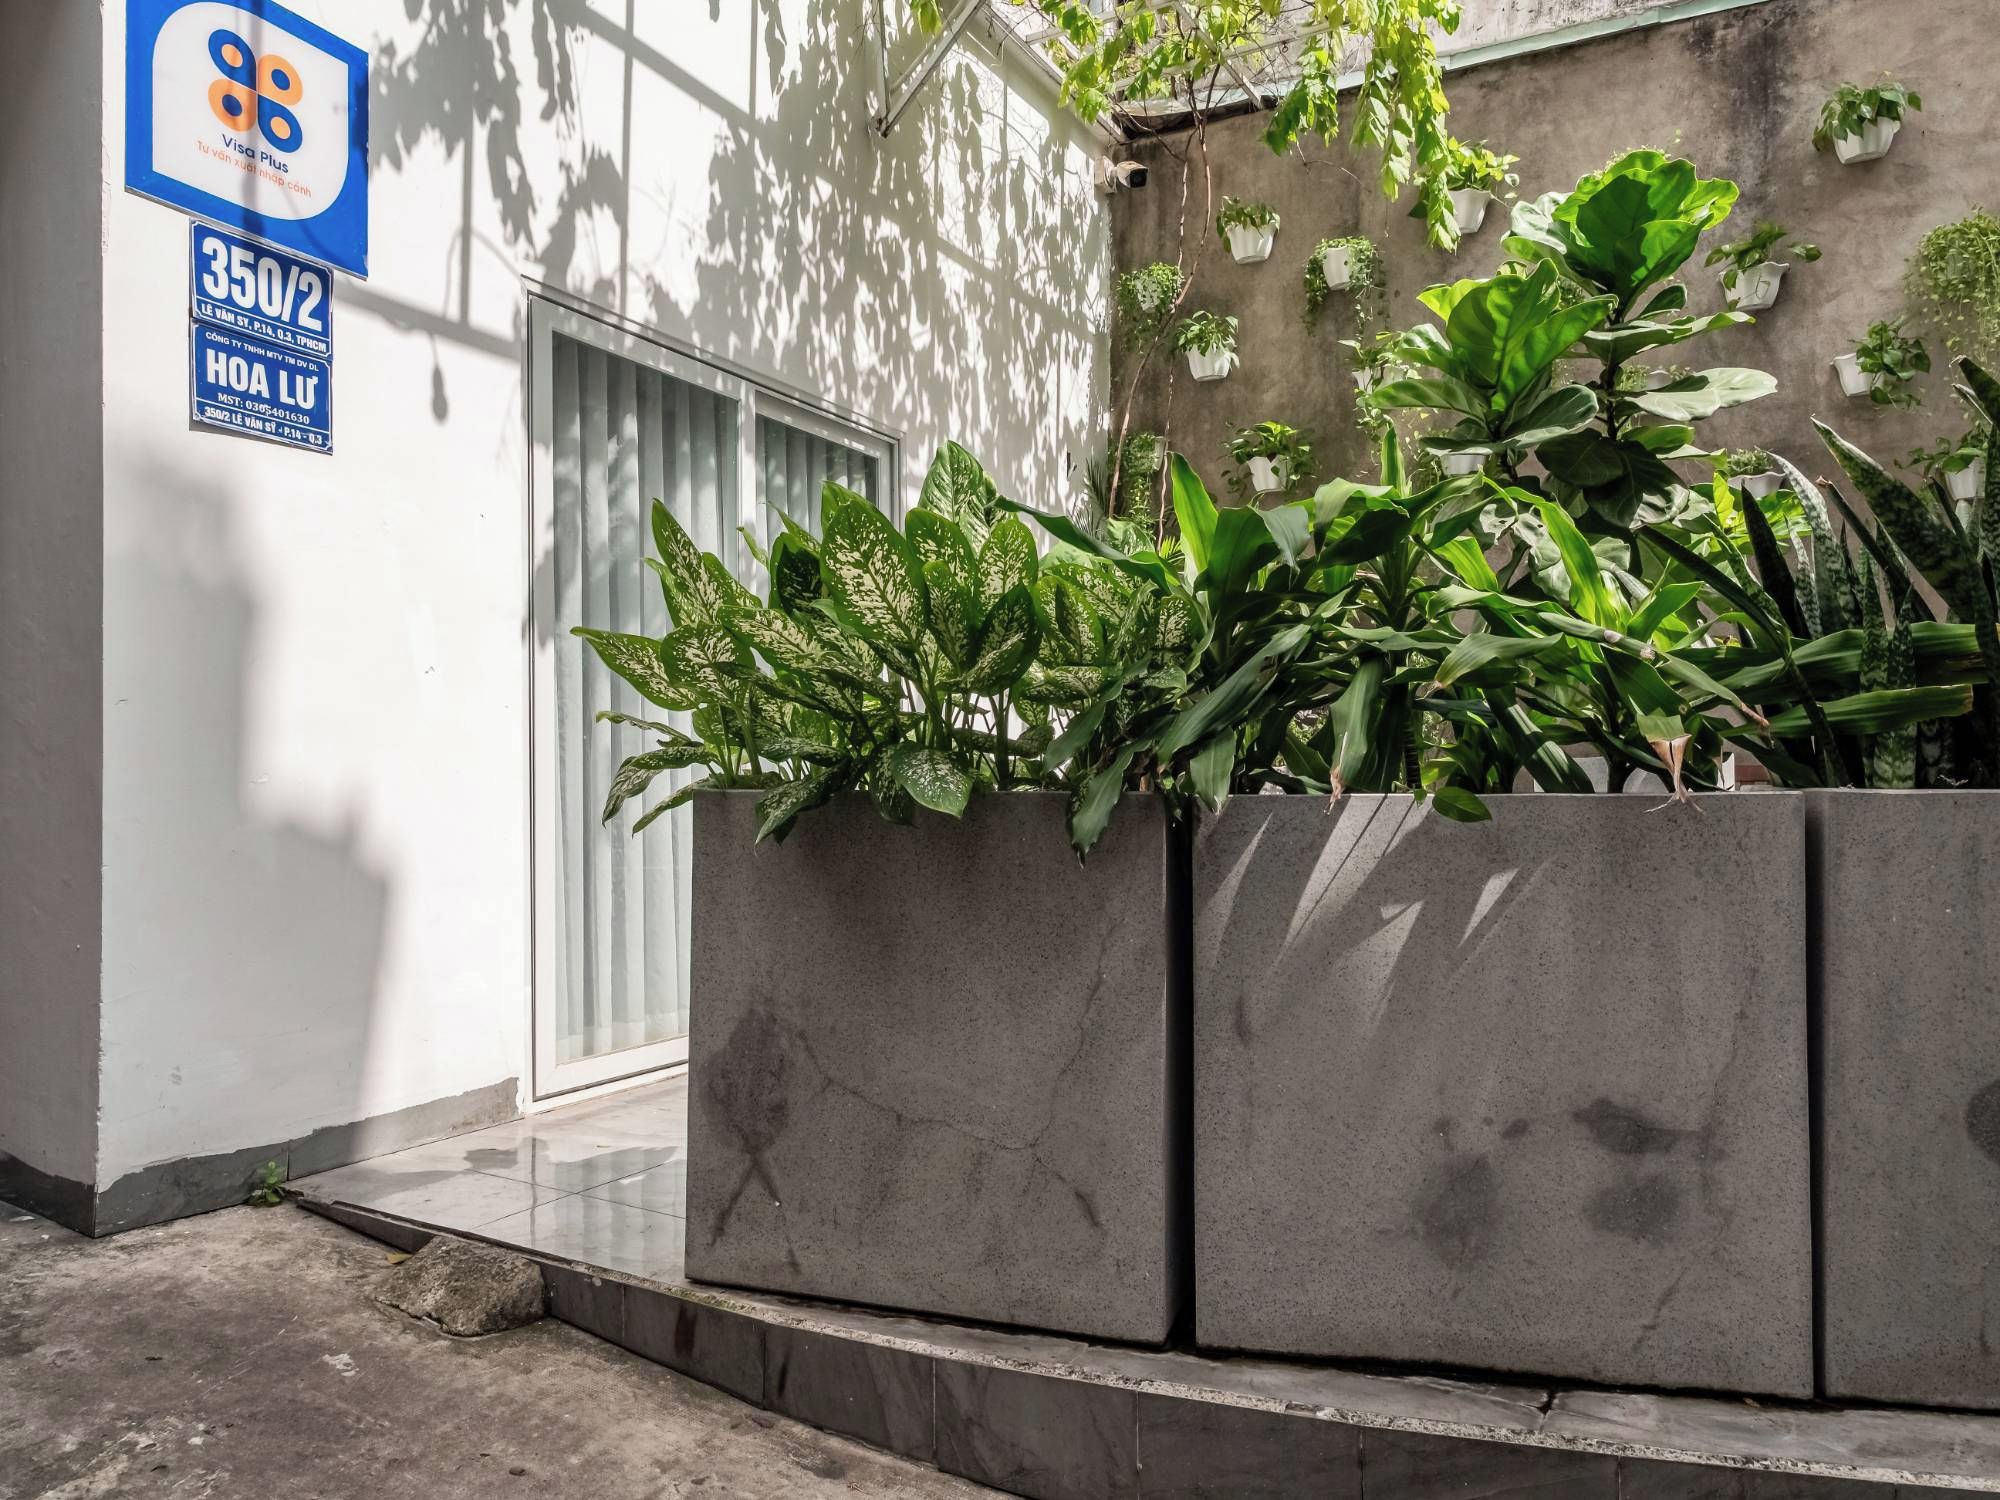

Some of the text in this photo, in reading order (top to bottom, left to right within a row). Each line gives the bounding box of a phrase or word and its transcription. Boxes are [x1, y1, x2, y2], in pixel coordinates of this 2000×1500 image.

[222, 134, 289, 173] Visa Plus
[202, 236, 323, 332] 350/2
[202, 302, 213, 316] LÊ
[254, 319, 275, 337] P.14,
[296, 334, 327, 353] TPHCM
[205, 331, 230, 345] CÔNG
[232, 339, 242, 349] TY
[244, 343, 265, 356] TNHH
[267, 350, 283, 361] MTV
[284, 356, 296, 365] TM
[297, 359, 307, 369] DV
[206, 348, 319, 410] HOA LƯ
[218, 392, 244, 408] MST:
[205, 406, 231, 422] 350/2
[232, 411, 243, 425] LÊ
[283, 426, 302, 440] P.14
[309, 433, 323, 445] Q.3
